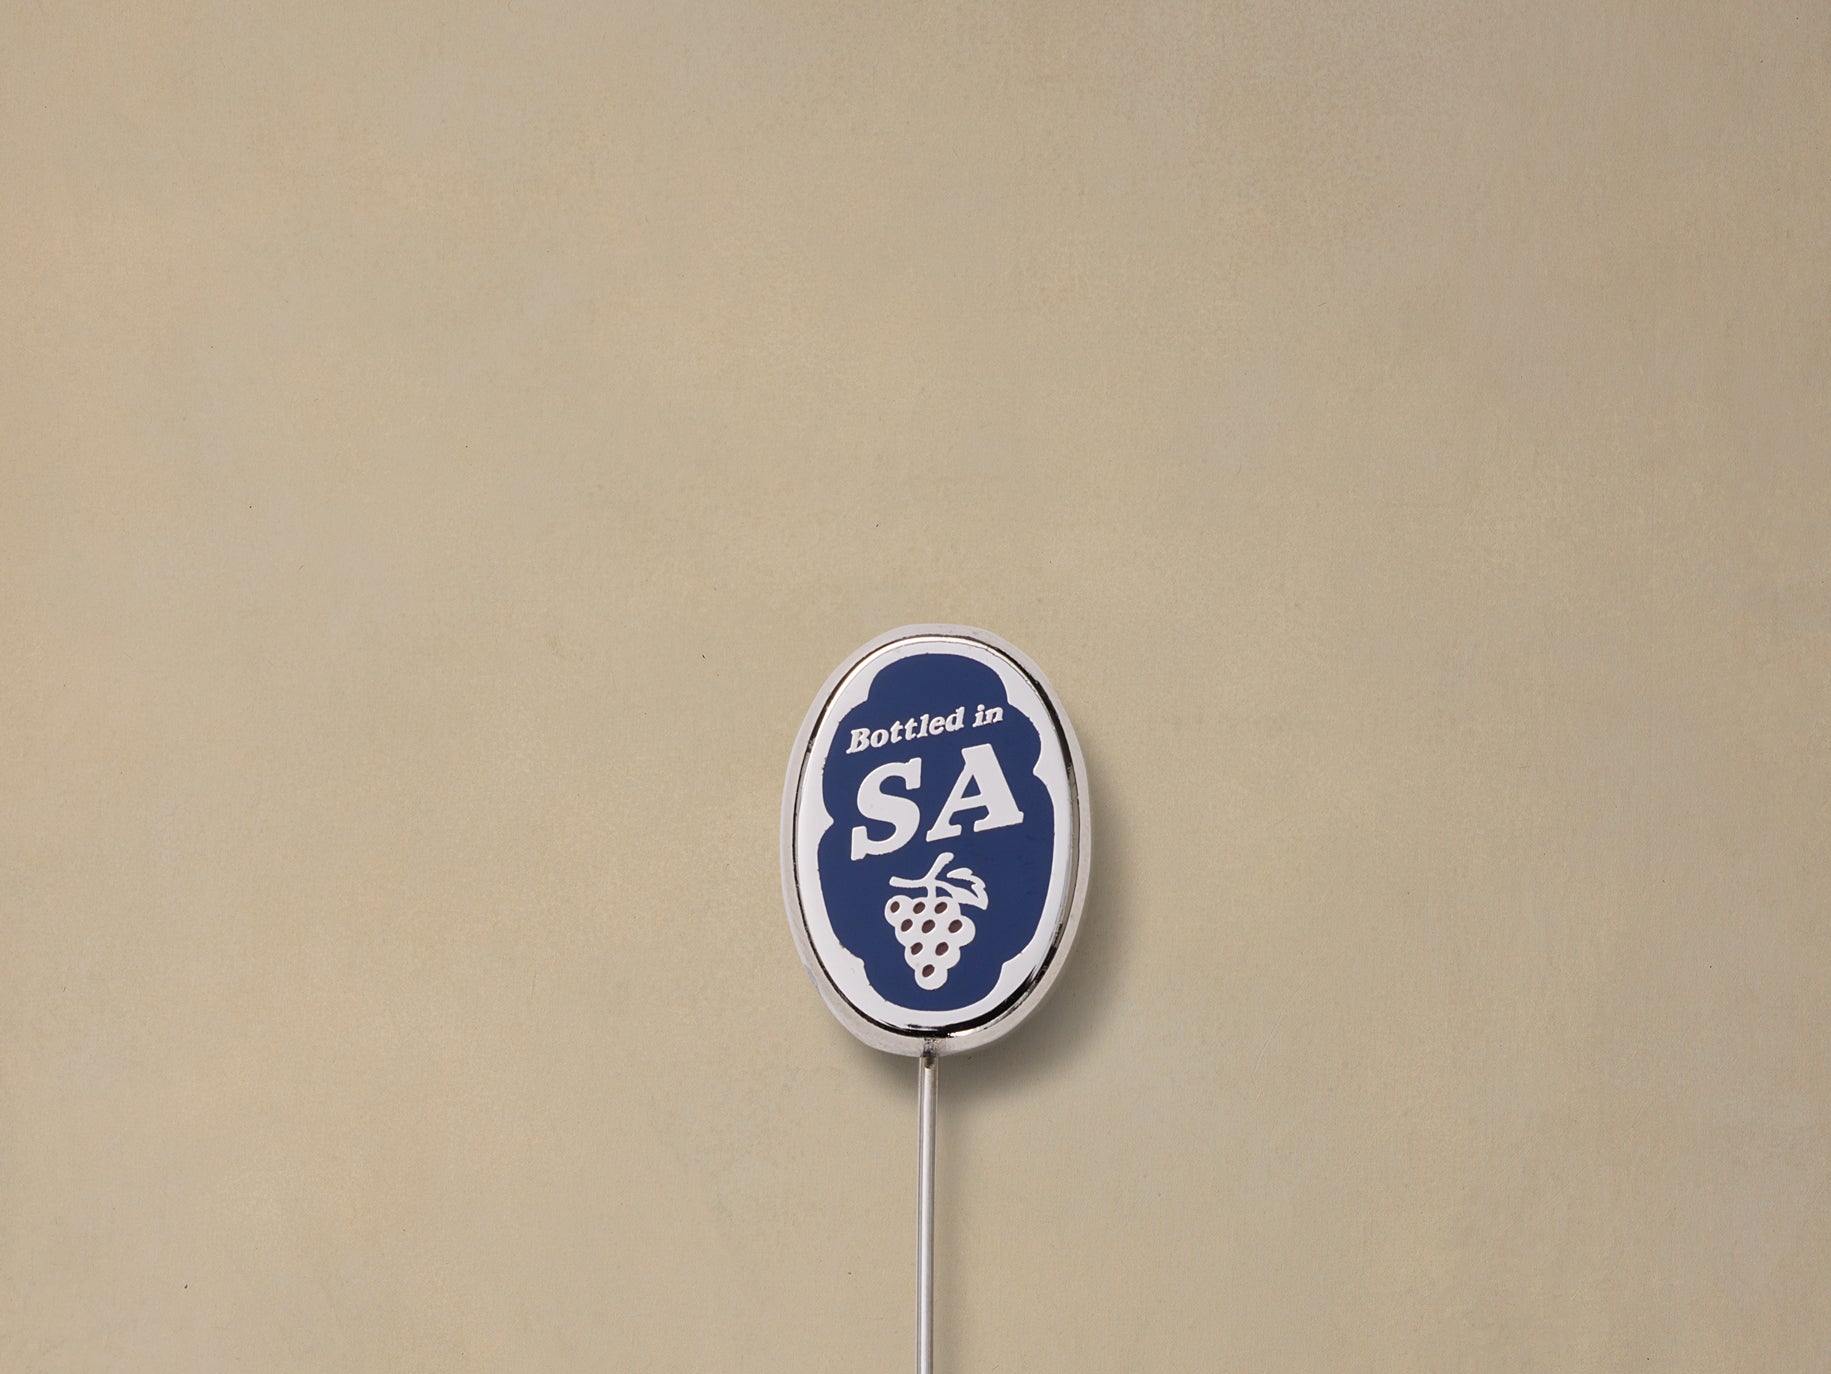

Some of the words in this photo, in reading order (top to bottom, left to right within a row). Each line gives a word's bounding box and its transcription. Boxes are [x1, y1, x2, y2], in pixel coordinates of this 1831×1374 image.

[846, 706, 965, 754] Bottled
[973, 704, 1004, 728] in
[850, 743, 1024, 861] SA
